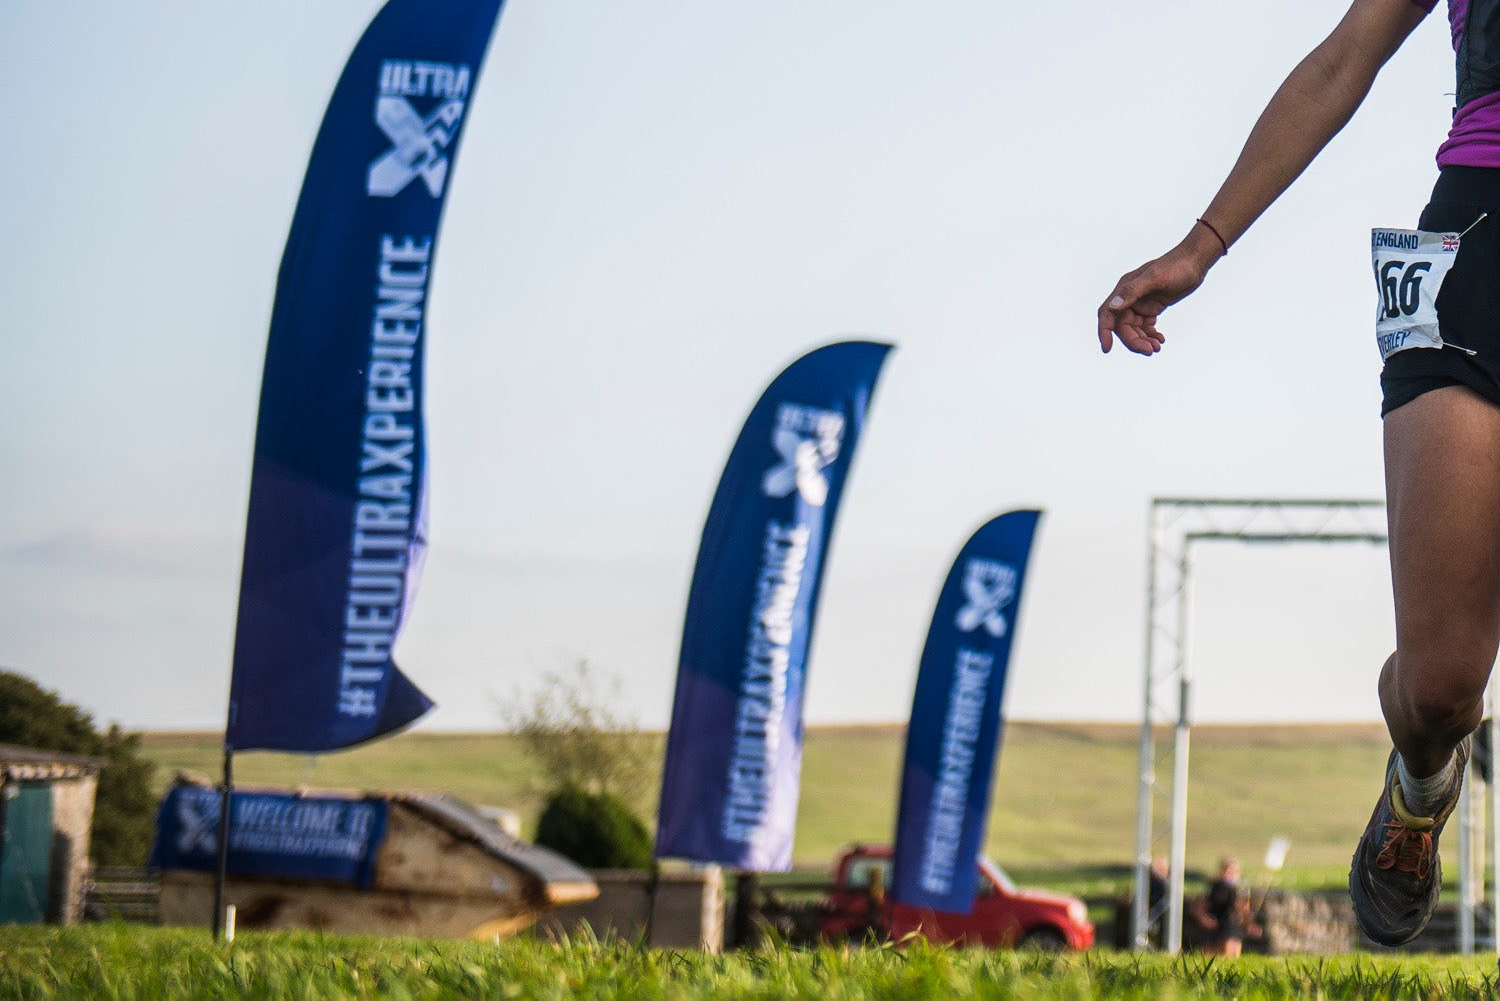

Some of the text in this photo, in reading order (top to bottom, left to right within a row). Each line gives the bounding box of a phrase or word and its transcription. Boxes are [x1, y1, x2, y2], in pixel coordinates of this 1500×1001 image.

[380, 61, 470, 99] ULTRA
[1376, 231, 1419, 250] ENGLAND
[338, 234, 432, 716] #THEULTRAXPERIENCE
